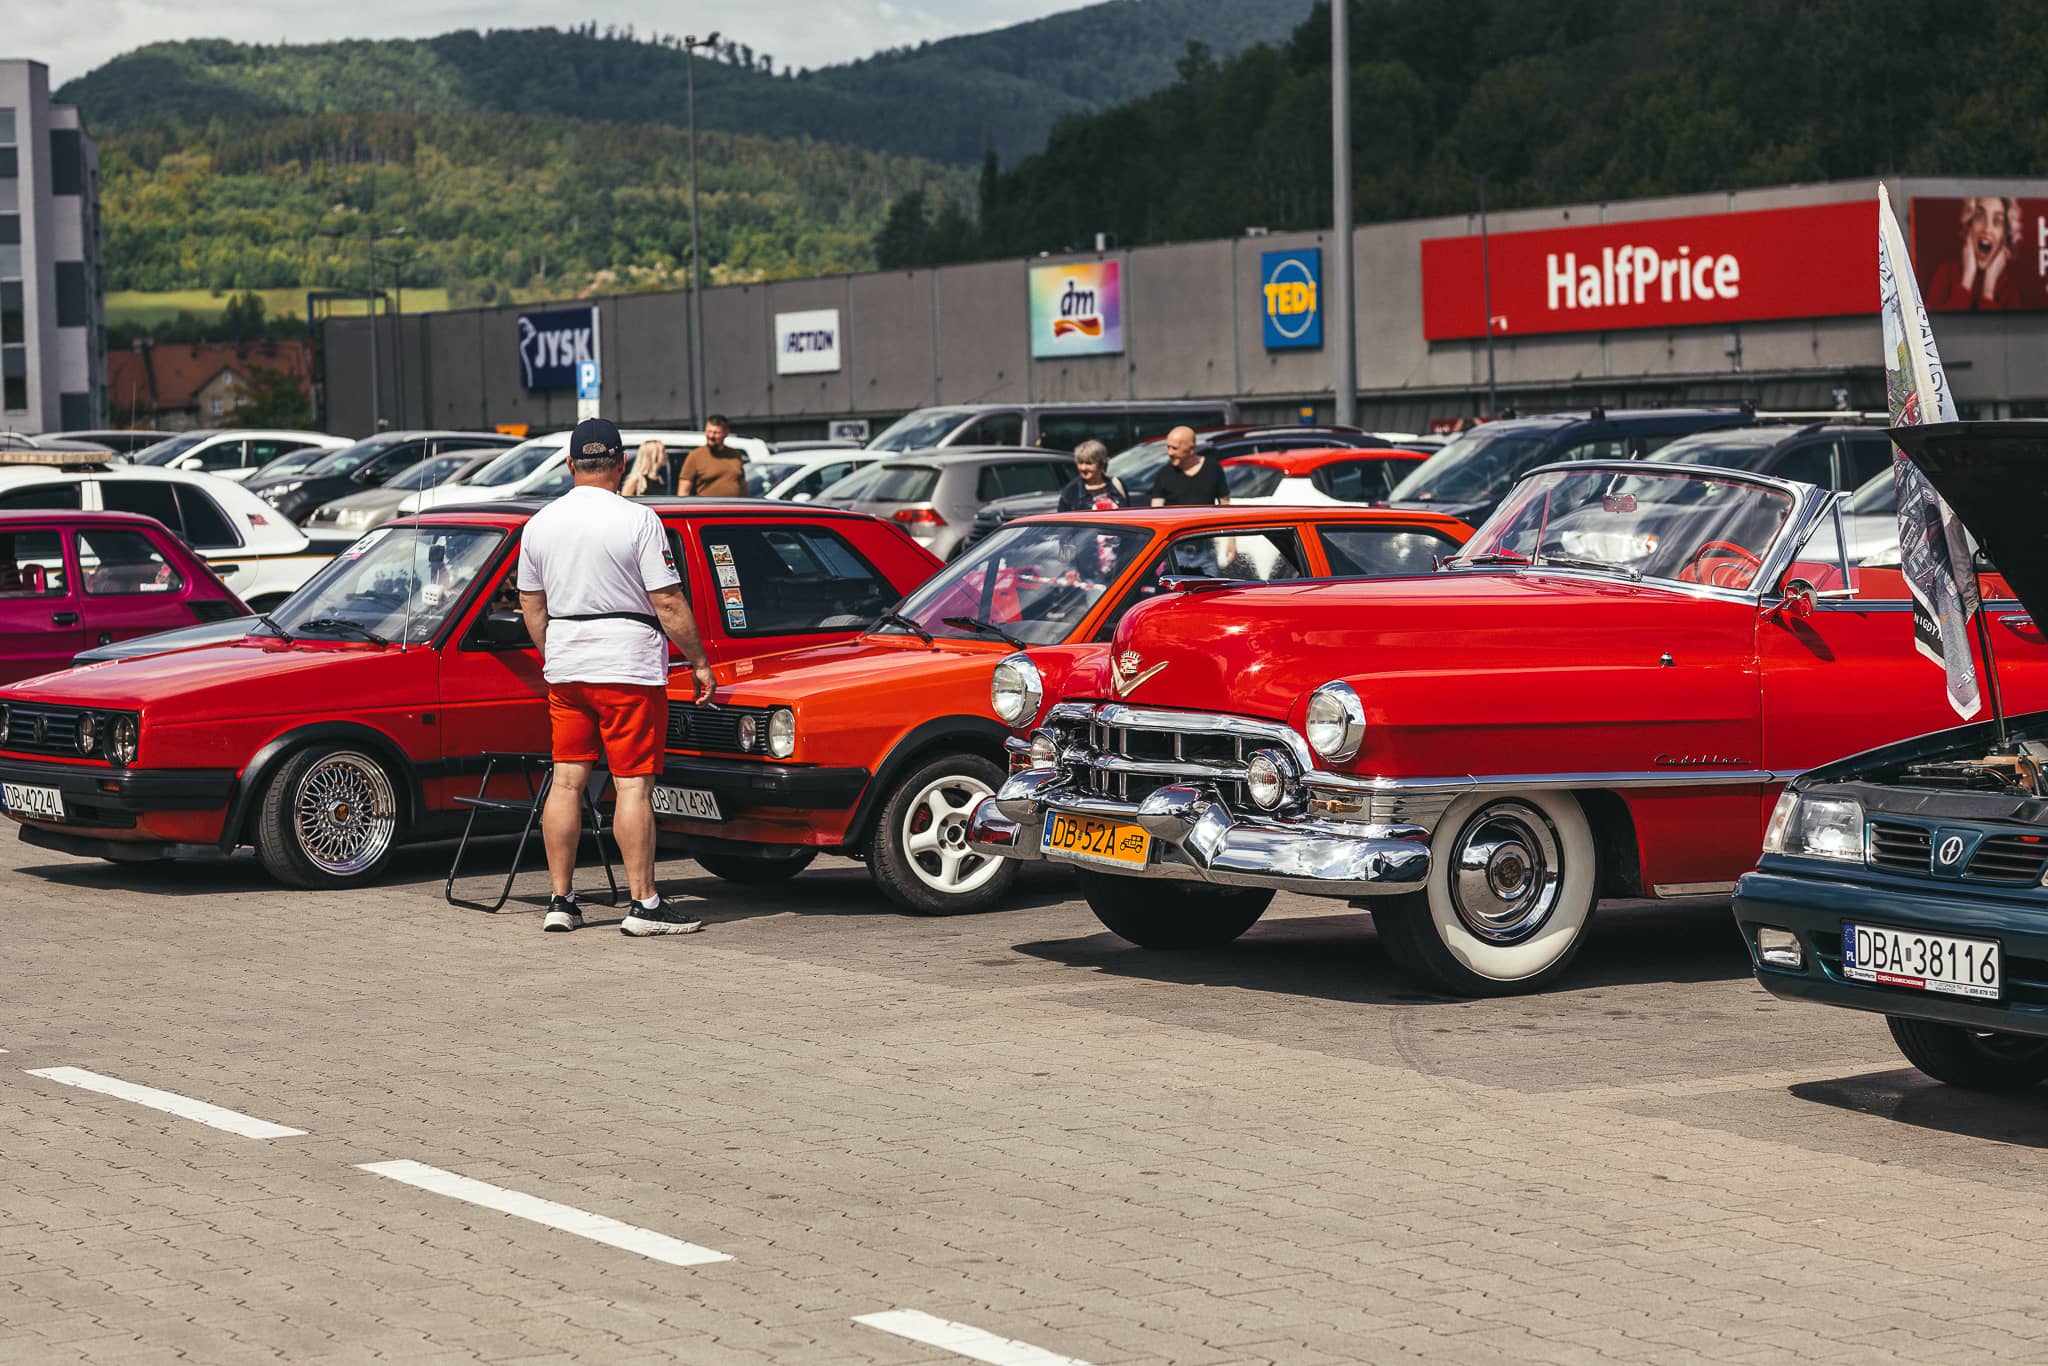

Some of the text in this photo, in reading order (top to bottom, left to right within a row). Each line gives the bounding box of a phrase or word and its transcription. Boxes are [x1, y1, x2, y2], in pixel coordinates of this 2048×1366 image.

[1546, 245, 1741, 310] HalfPrice
[1060, 281, 1095, 317] dm
[1264, 280, 1317, 317] TEDi
[534, 328, 591, 368] JYSK
[785, 330, 834, 353] ACTION
[580, 363, 595, 389] P
[1654, 754, 1752, 767] Cadillac
[5, 785, 62, 815] DB 4224L
[670, 790, 718, 817] 2143M
[1053, 817, 1116, 855] DB 52A
[1846, 950, 1856, 962] PL
[1857, 929, 1996, 984] DBA 38116
